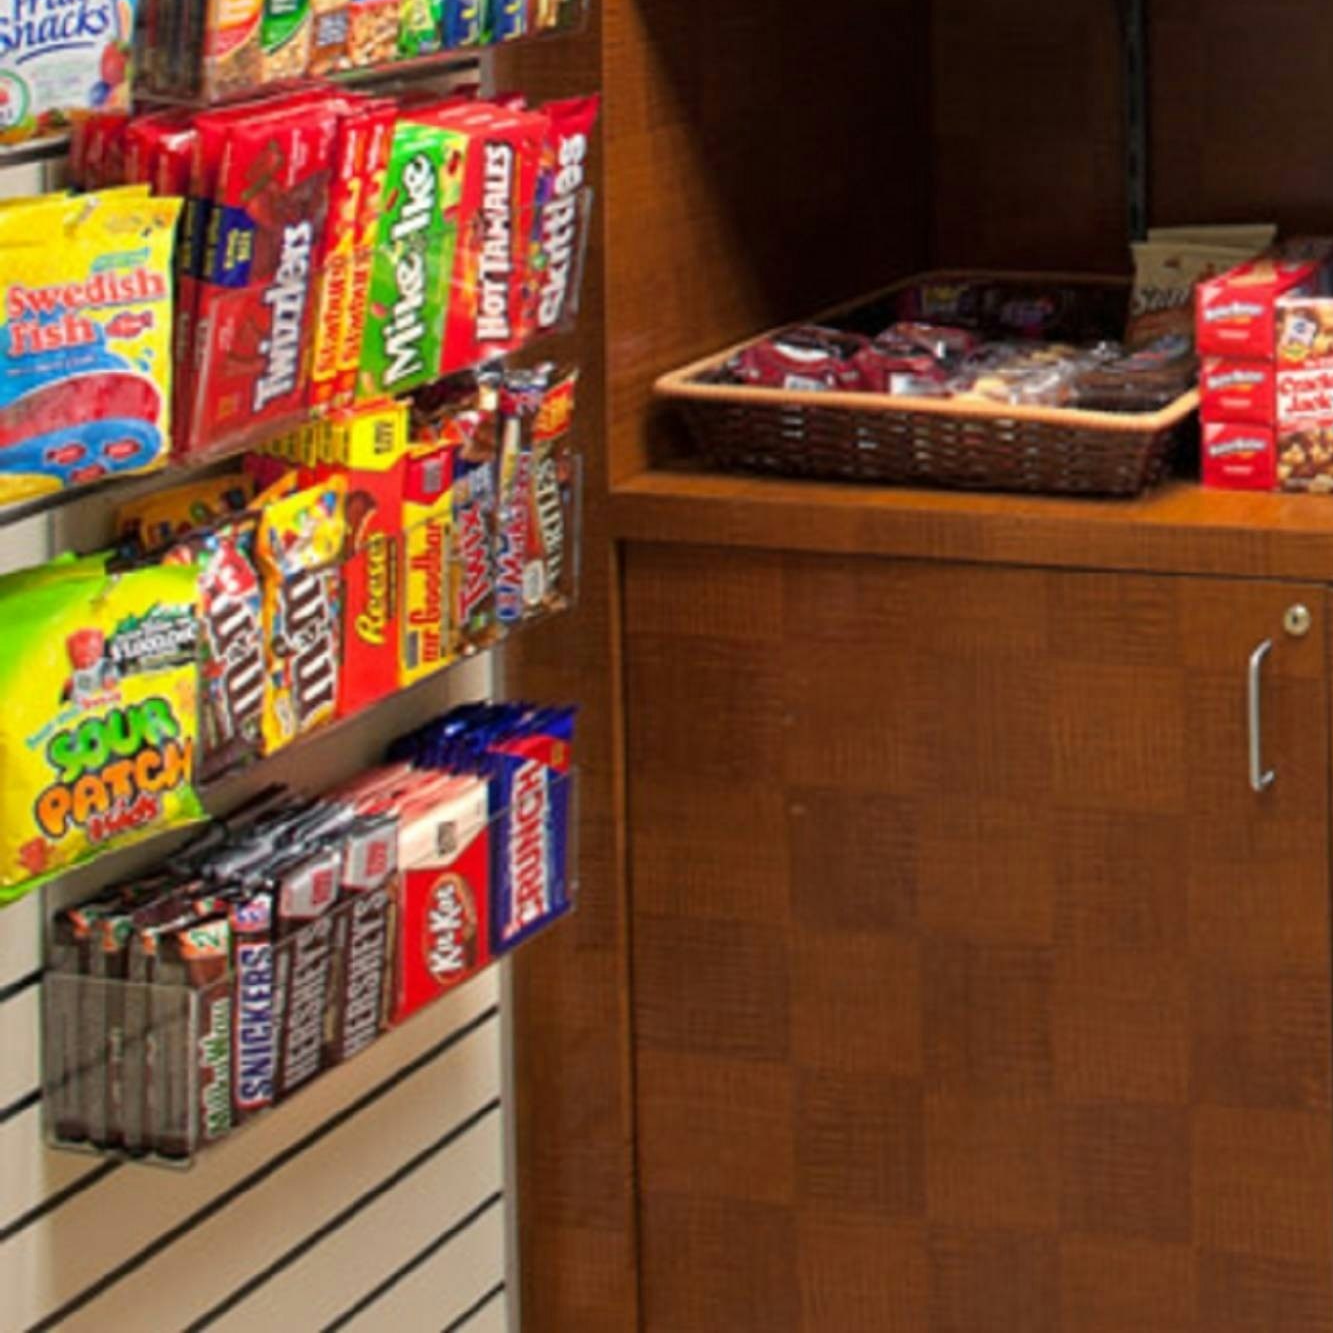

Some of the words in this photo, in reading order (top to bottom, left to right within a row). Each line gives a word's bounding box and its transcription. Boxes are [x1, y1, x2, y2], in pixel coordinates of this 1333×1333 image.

[391, 154, 439, 239] Ike
[477, 144, 512, 280] TAMALES
[6, 267, 166, 318] Swedish
[8, 313, 96, 358] Fish
[384, 248, 430, 385] Mike
[476, 281, 511, 341] HOT
[47, 697, 181, 784] SOUR
[35, 737, 194, 840] PATCH
[503, 759, 549, 942] CRUNCH
[238, 944, 273, 1102] SNICKERS
